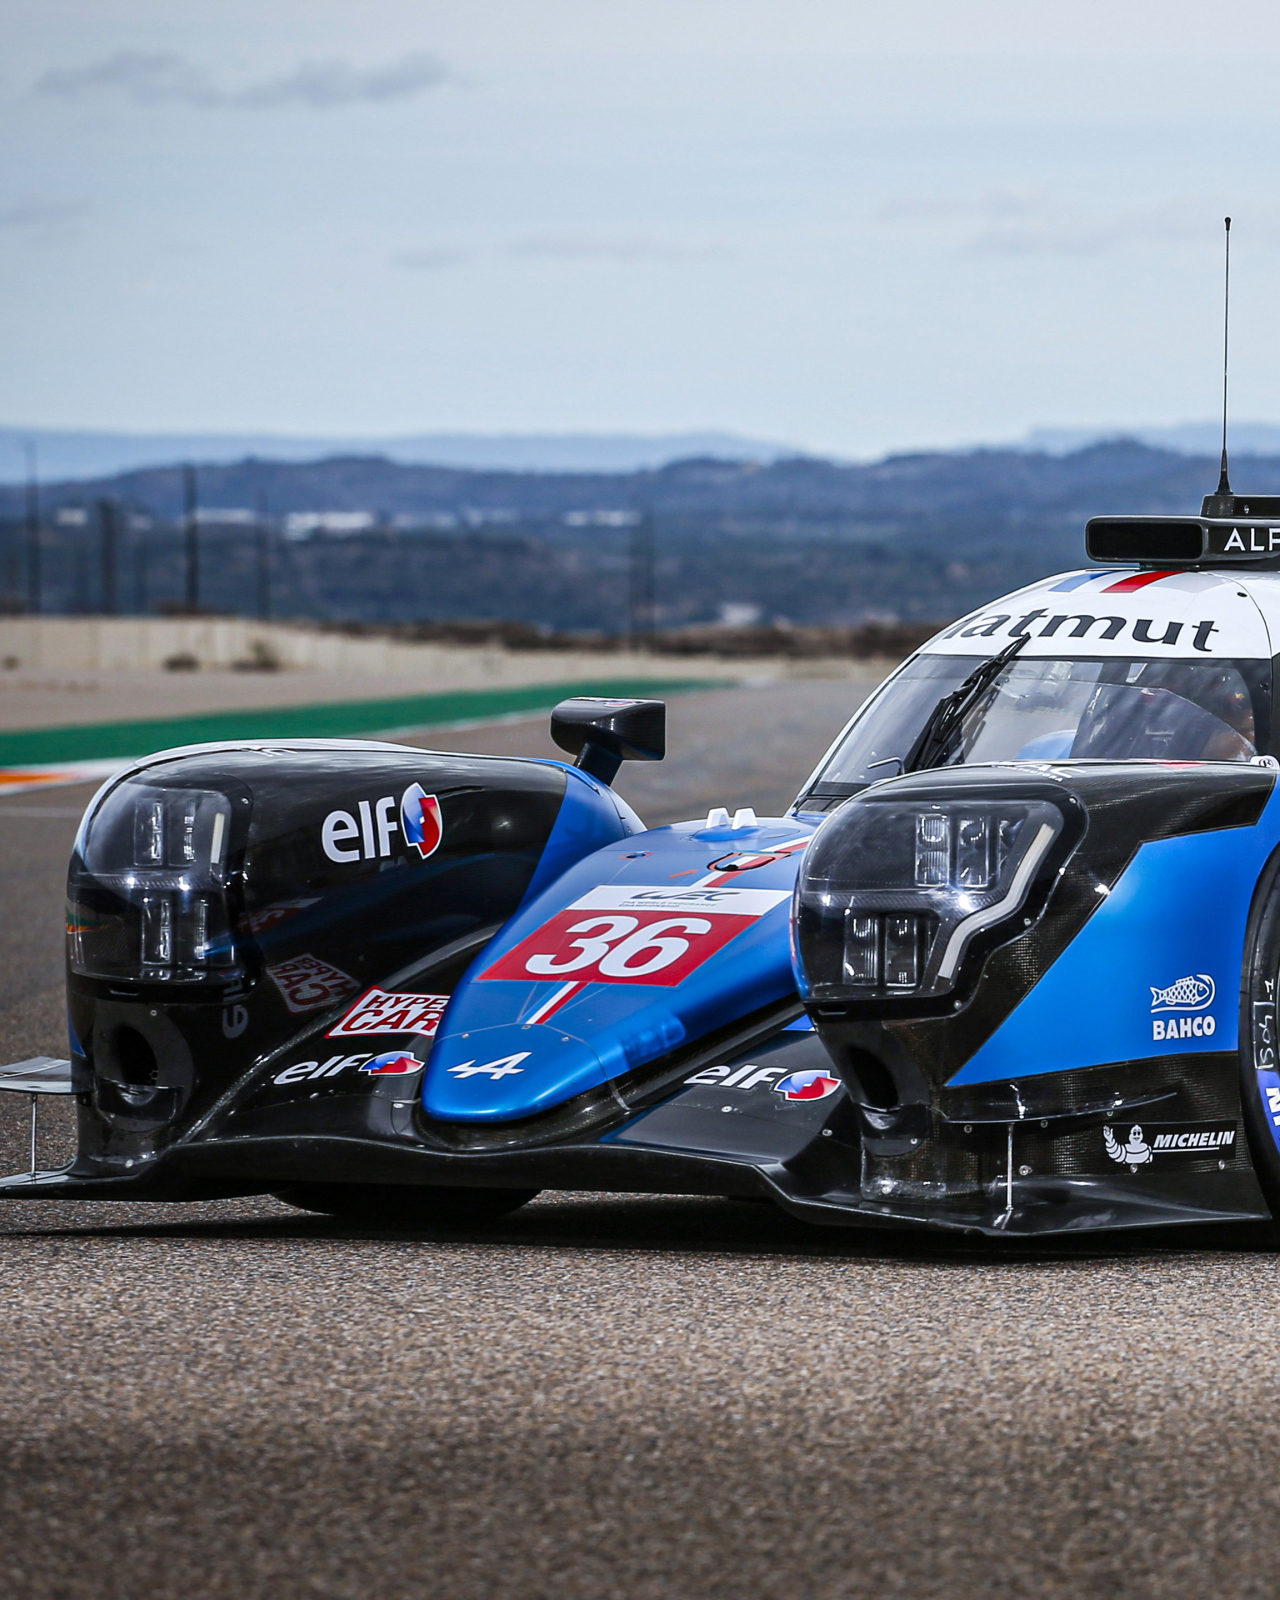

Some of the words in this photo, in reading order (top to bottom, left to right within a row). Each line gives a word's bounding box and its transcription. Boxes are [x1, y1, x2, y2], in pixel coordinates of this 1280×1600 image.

[321, 796, 399, 863] elf
[525, 915, 713, 977] 36
[363, 995, 448, 1009] HYPE
[1153, 1015, 1216, 1040] BAHCO
[273, 1053, 374, 1085] elf
[683, 1065, 789, 1089] elf
[1153, 1131, 1235, 1148] MICHELIN
